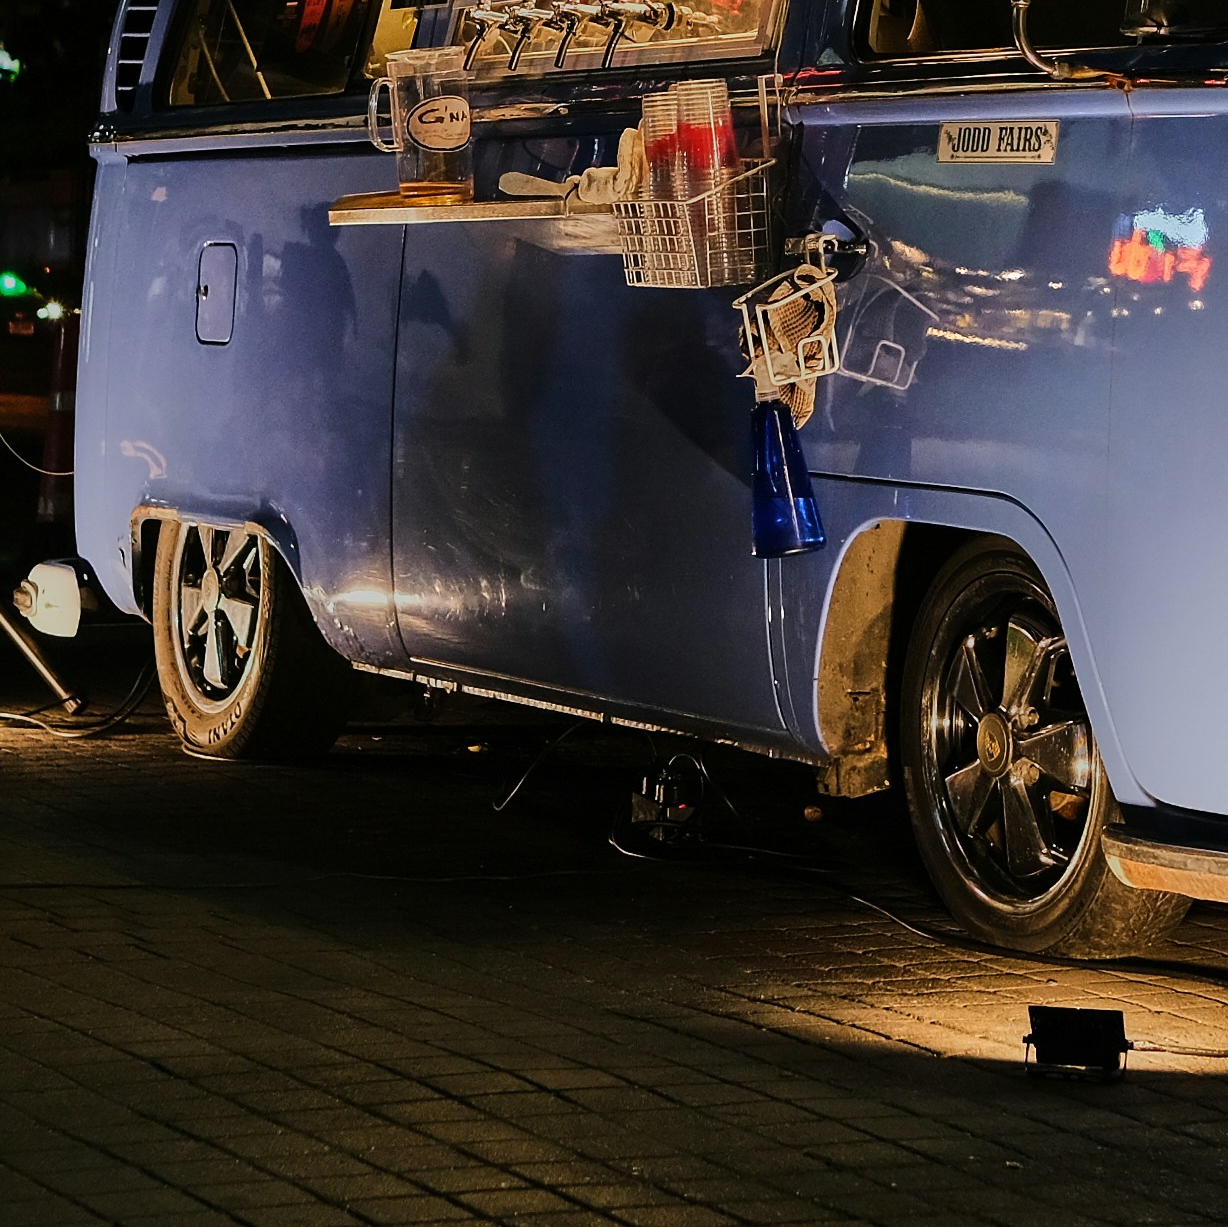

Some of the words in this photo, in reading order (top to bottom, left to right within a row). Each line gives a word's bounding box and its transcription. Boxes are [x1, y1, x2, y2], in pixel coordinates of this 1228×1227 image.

[951, 127, 992, 153] JODD
[996, 126, 1043, 153] FAIRS
[208, 701, 242, 744] OTANI
